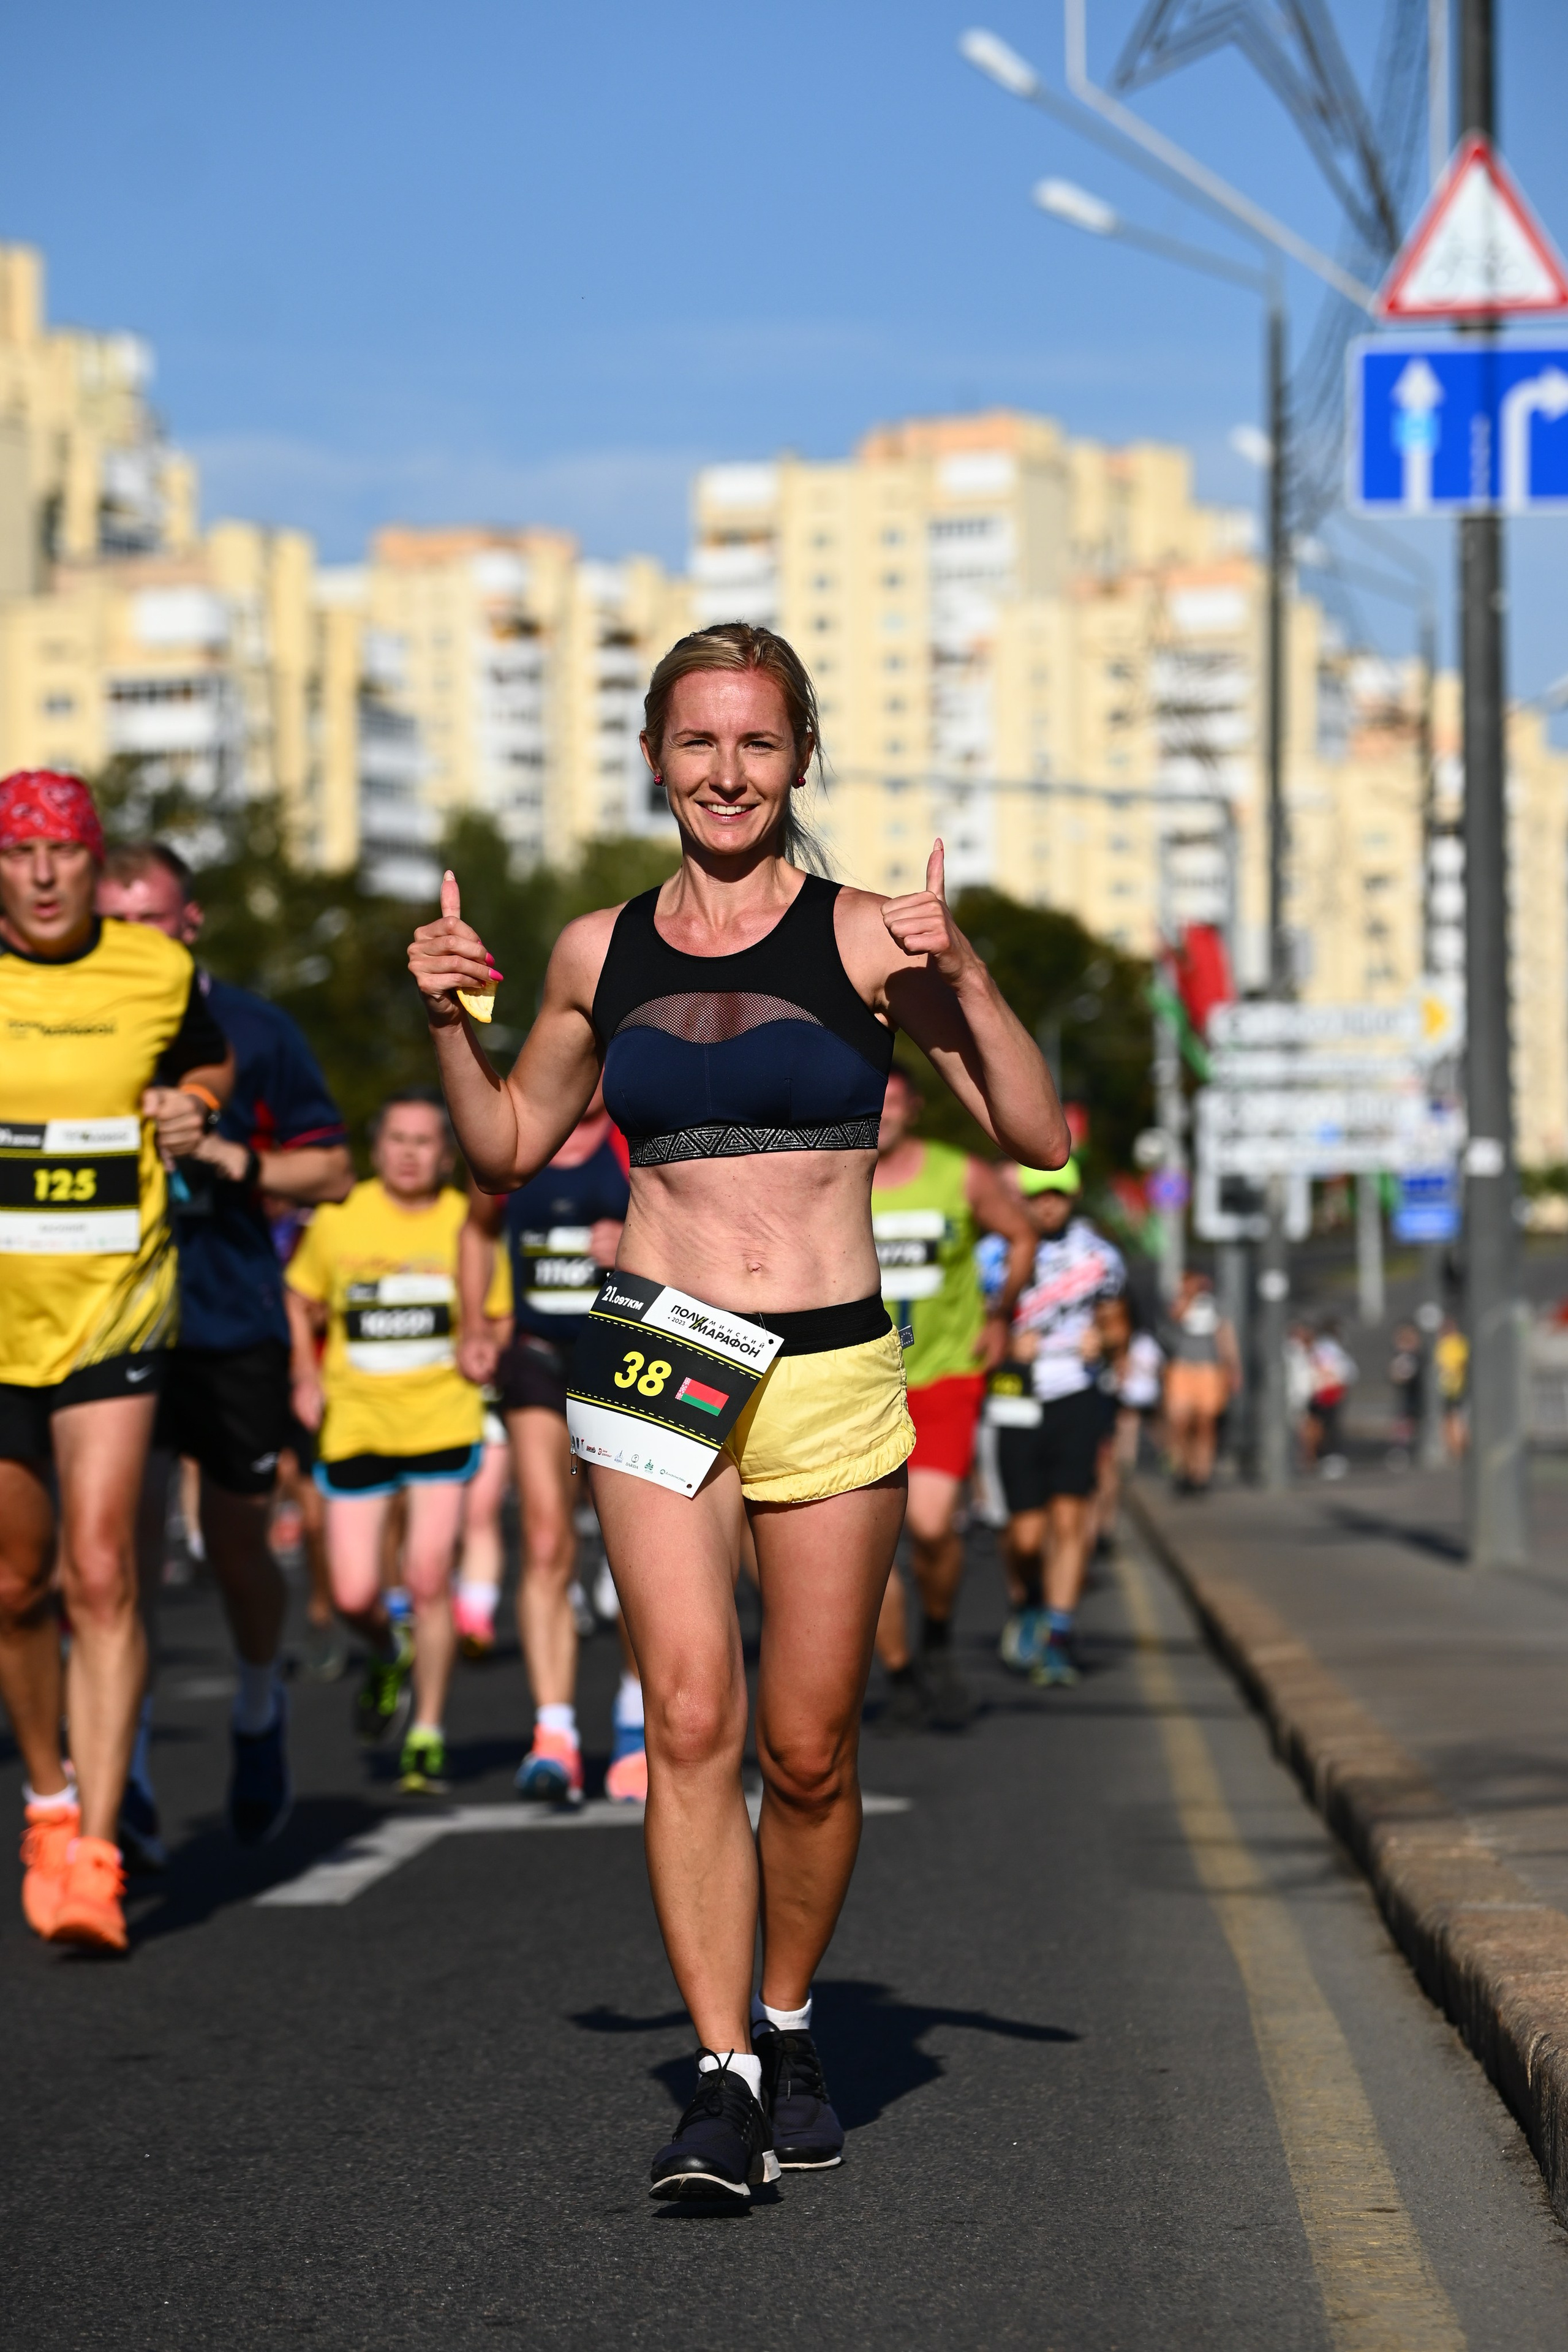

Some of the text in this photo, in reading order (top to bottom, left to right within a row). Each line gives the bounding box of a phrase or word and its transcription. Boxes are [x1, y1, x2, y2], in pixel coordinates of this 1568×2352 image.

[33, 1168, 97, 1201] 125
[671, 1305, 708, 1329] ПОЛУ
[671, 1317, 686, 1326] 2023
[692, 1322, 761, 1358] МАРАФОН
[709, 1320, 765, 1349] МИНСКИЙ
[614, 1351, 673, 1397] 38
